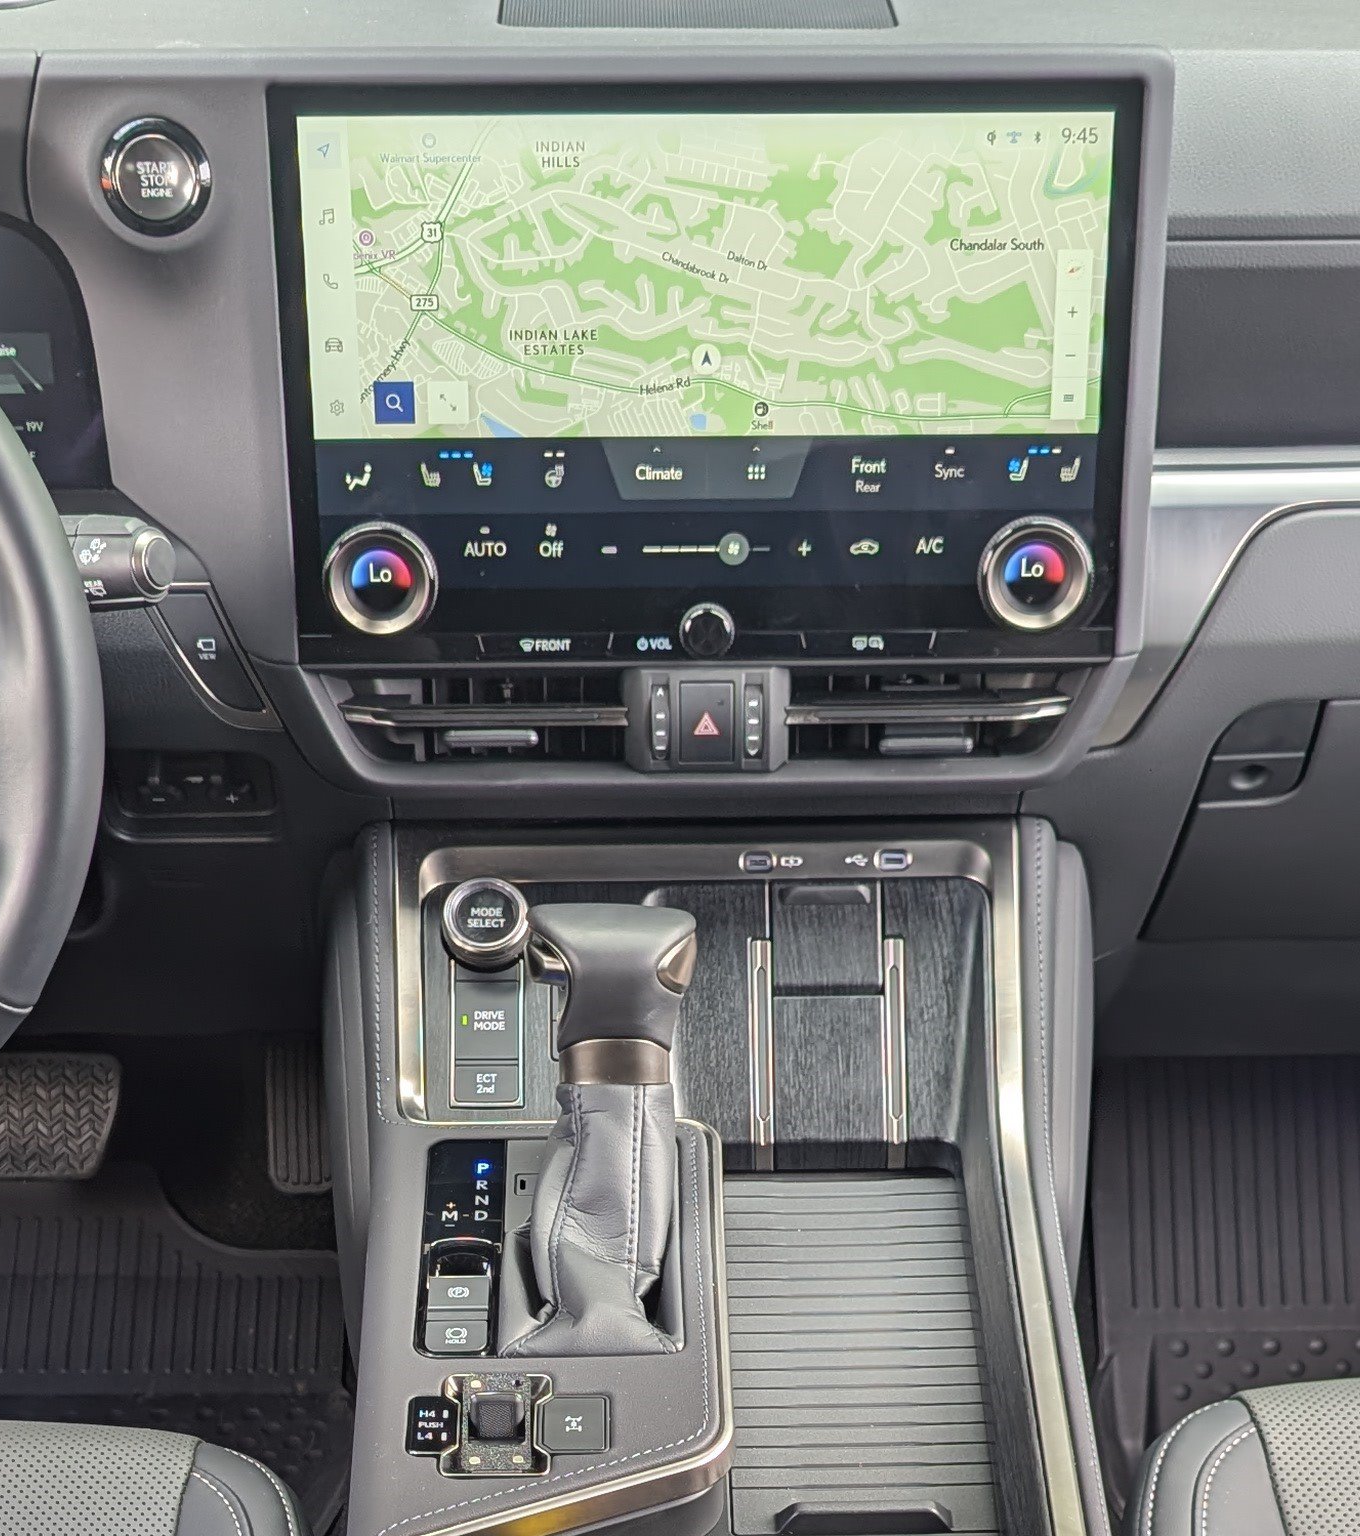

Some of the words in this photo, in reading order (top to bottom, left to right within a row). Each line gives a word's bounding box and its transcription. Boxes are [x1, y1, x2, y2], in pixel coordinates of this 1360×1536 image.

[1061, 127, 1098, 144] 9:45
[536, 141, 585, 152] INDIAN
[380, 153, 420, 163] Walmart
[423, 152, 481, 165] Supercenter
[542, 157, 580, 168] HILLS
[141, 188, 173, 198] ENGINE
[427, 228, 437, 238] 31
[950, 238, 1007, 251] Chandalar
[1010, 238, 1044, 251] South
[381, 250, 396, 260] VR
[727, 251, 755, 268] Dalton
[757, 260, 768, 271] Dr
[662, 251, 716, 280] Chandabrook
[719, 273, 729, 284] Dr
[415, 298, 434, 308] 275
[509, 330, 558, 341] INDIAN
[564, 330, 597, 341] LAKE
[391, 338, 411, 362] Hwy
[524, 345, 584, 355] ESTATES
[640, 381, 674, 396] Helena
[676, 377, 691, 388] Rd
[751, 421, 773, 430] Shell
[851, 457, 886, 475] Front
[934, 464, 965, 479] Sync
[635, 464, 683, 481] Climate
[855, 480, 881, 494] Rear
[464, 542, 507, 558] AUTO
[539, 541, 564, 558] Off
[916, 536, 944, 555] A/C
[369, 563, 392, 583] Lo
[1020, 557, 1044, 578] Lo
[536, 639, 572, 652] FRONT
[650, 638, 673, 651] VOL
[470, 908, 503, 918] MODE
[467, 919, 506, 929] SELECT
[473, 1011, 506, 1020] DRIVE
[473, 1021, 506, 1031] MODE
[476, 1073, 498, 1083] ECT
[476, 1084, 496, 1094] 2nd
[477, 1163, 490, 1174] P
[476, 1180, 489, 1190] R
[475, 1195, 489, 1205] N
[441, 1210, 458, 1221] M
[474, 1210, 488, 1221] D
[419, 1410, 436, 1418] H4
[417, 1432, 433, 1440] L4
